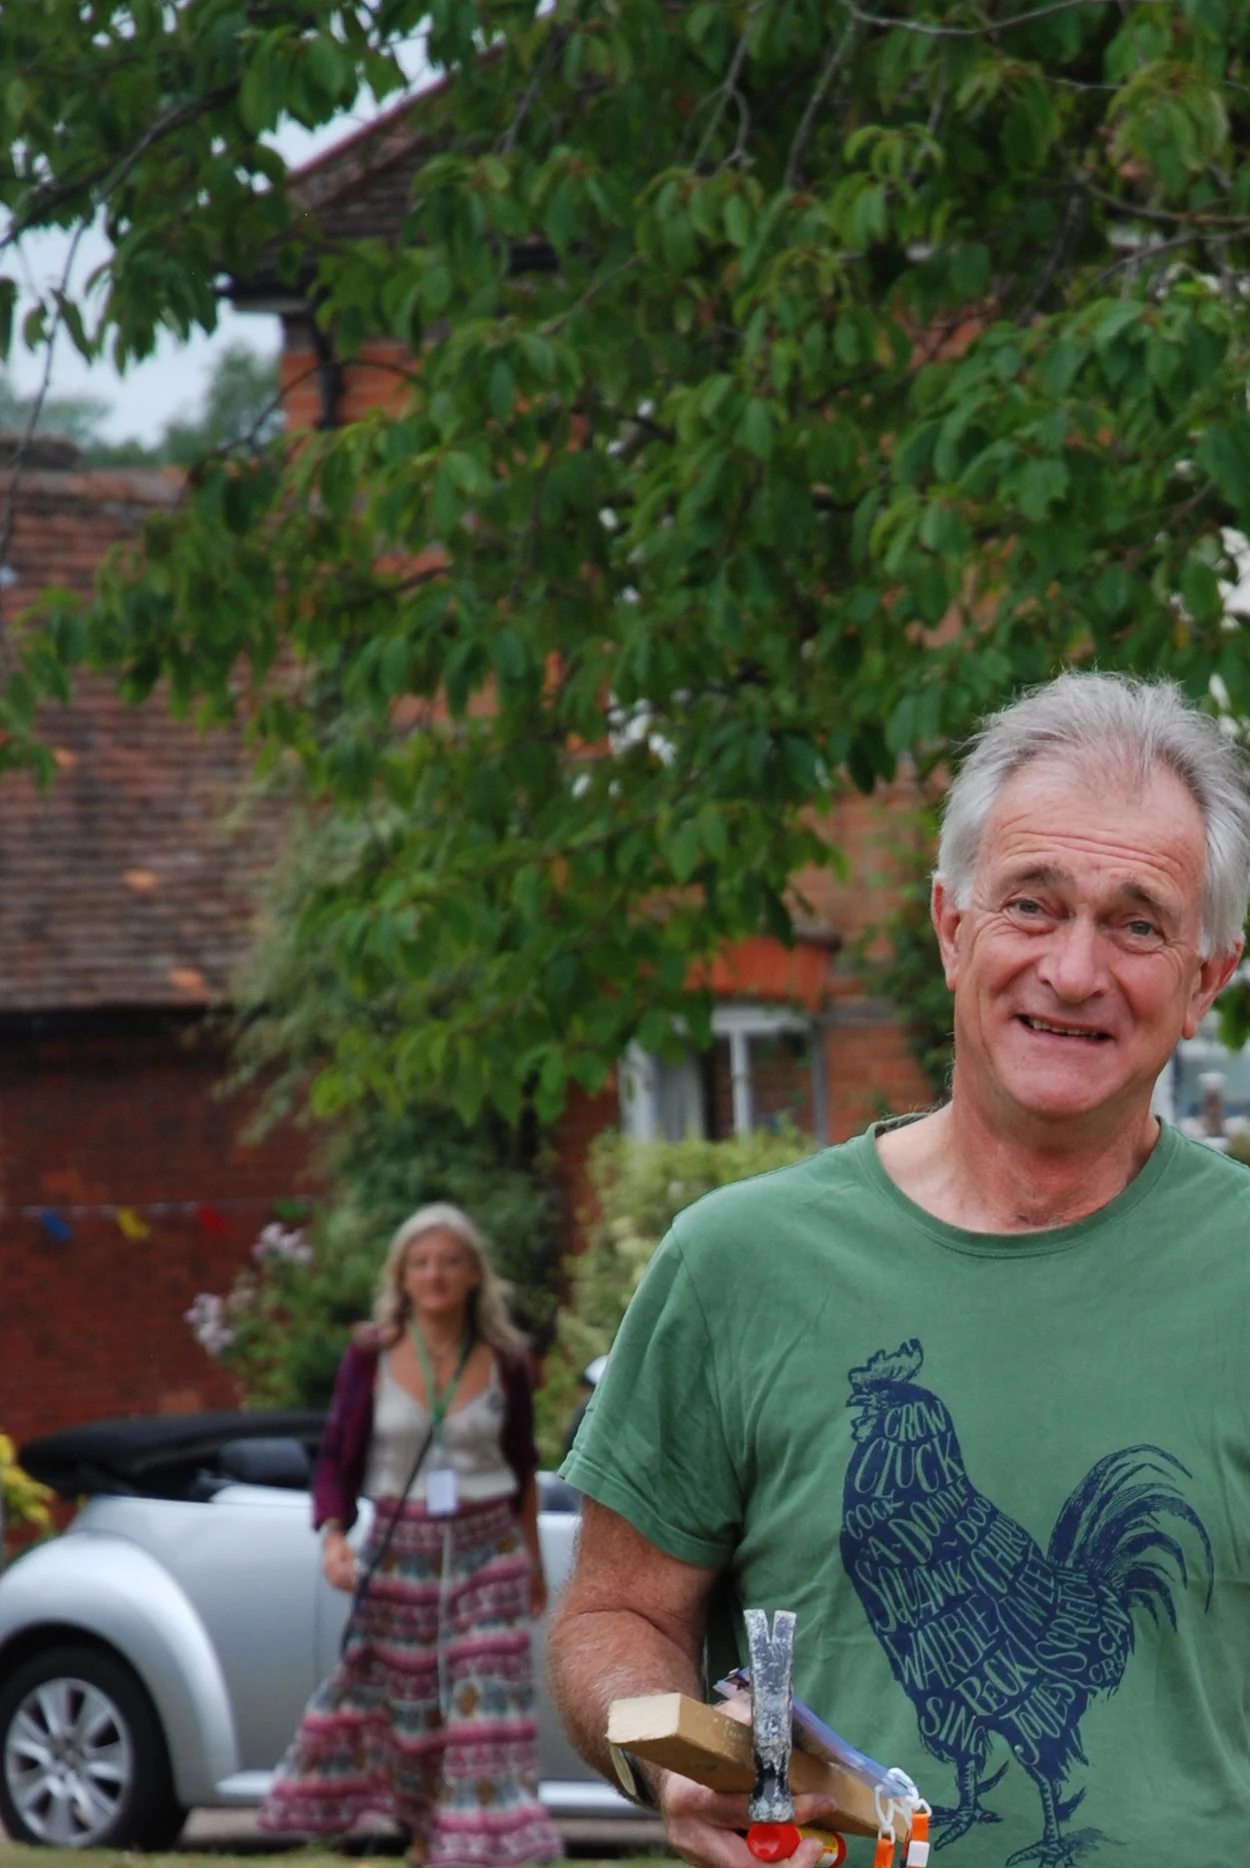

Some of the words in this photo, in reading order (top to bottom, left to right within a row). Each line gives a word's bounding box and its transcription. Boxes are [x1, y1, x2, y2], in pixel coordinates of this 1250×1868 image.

[884, 1401, 946, 1441] CROW
[854, 1431, 965, 1499] CLUCK
[845, 1499, 905, 1540] COCK
[855, 1556, 973, 1633] SQUAWK
[883, 1593, 1000, 1691] WARBLE
[1088, 1649, 1125, 1684] CRY
[953, 1639, 1039, 1717] PECK
[920, 1696, 987, 1759] SING
